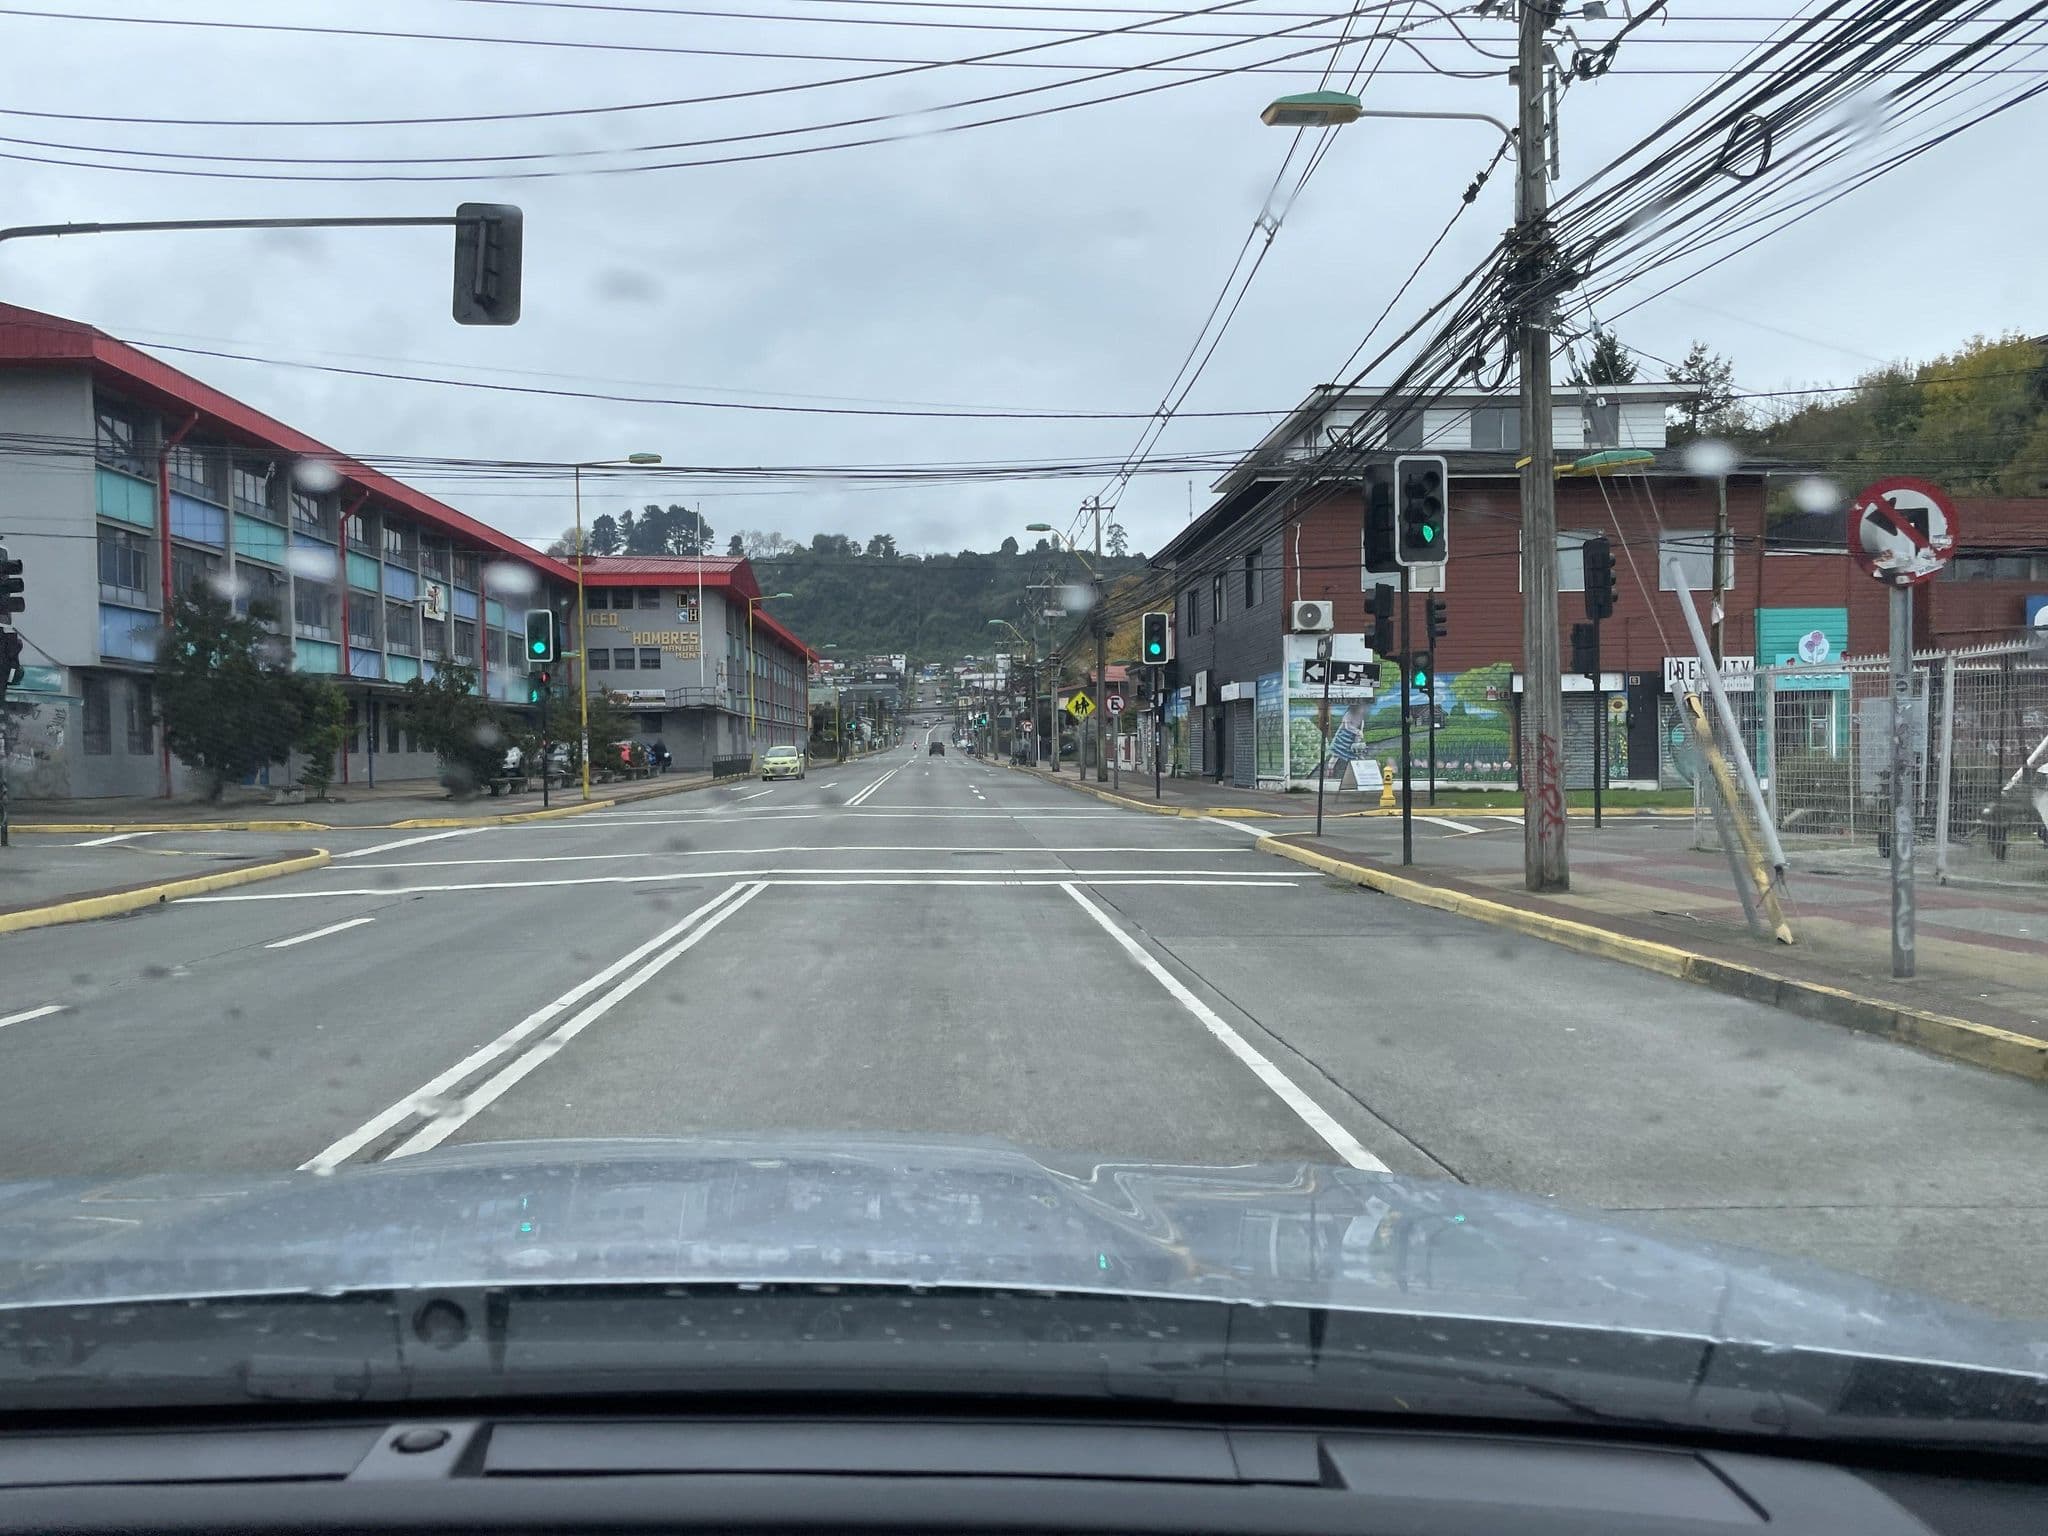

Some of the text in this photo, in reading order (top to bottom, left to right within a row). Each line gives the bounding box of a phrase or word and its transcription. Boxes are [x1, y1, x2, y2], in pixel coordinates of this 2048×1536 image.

[583, 612, 618, 627] ICEO
[689, 609, 698, 621] H
[632, 632, 699, 645] HOMBRES
[1668, 660, 1750, 681] IDEITY
